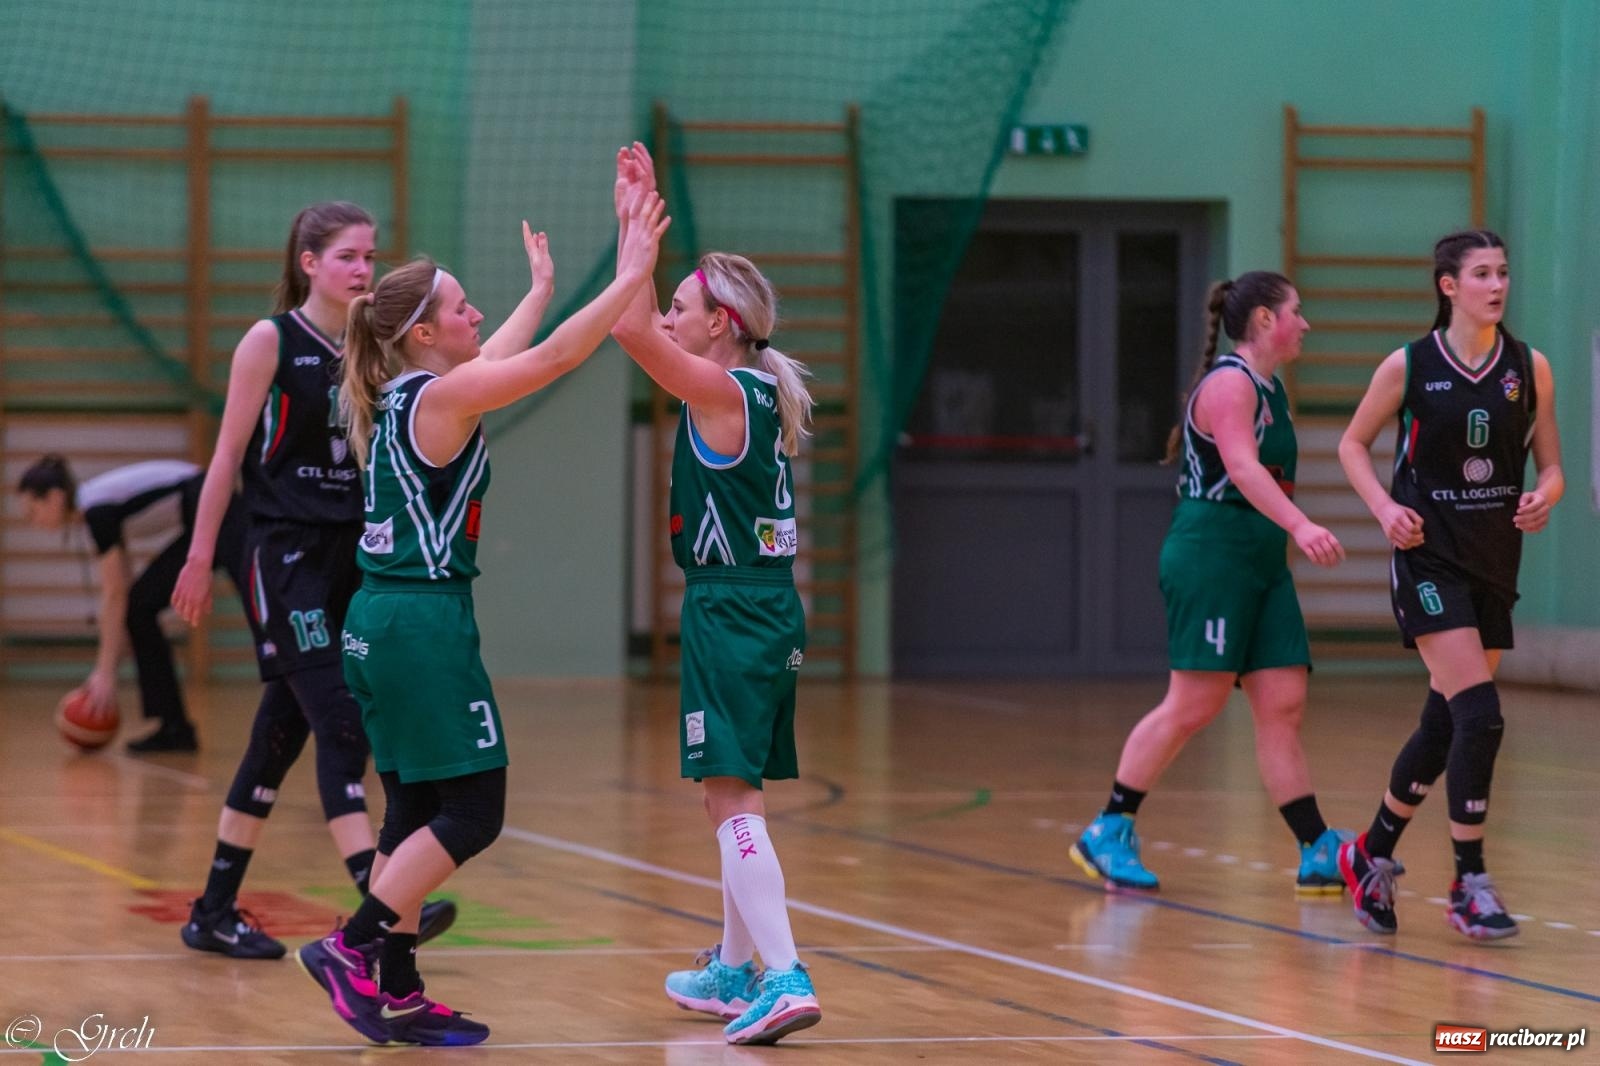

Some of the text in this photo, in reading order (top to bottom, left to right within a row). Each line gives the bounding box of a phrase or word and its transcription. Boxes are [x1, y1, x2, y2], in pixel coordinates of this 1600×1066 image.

[1466, 409, 1490, 448] 6
[297, 466, 324, 478] CTL
[1431, 485, 1518, 500] CTL LOGISTIC
[1417, 581, 1444, 616] 6
[290, 608, 330, 652] 13
[1205, 617, 1226, 656] 4
[469, 700, 498, 749] 3
[731, 816, 757, 860] ALLSIX
